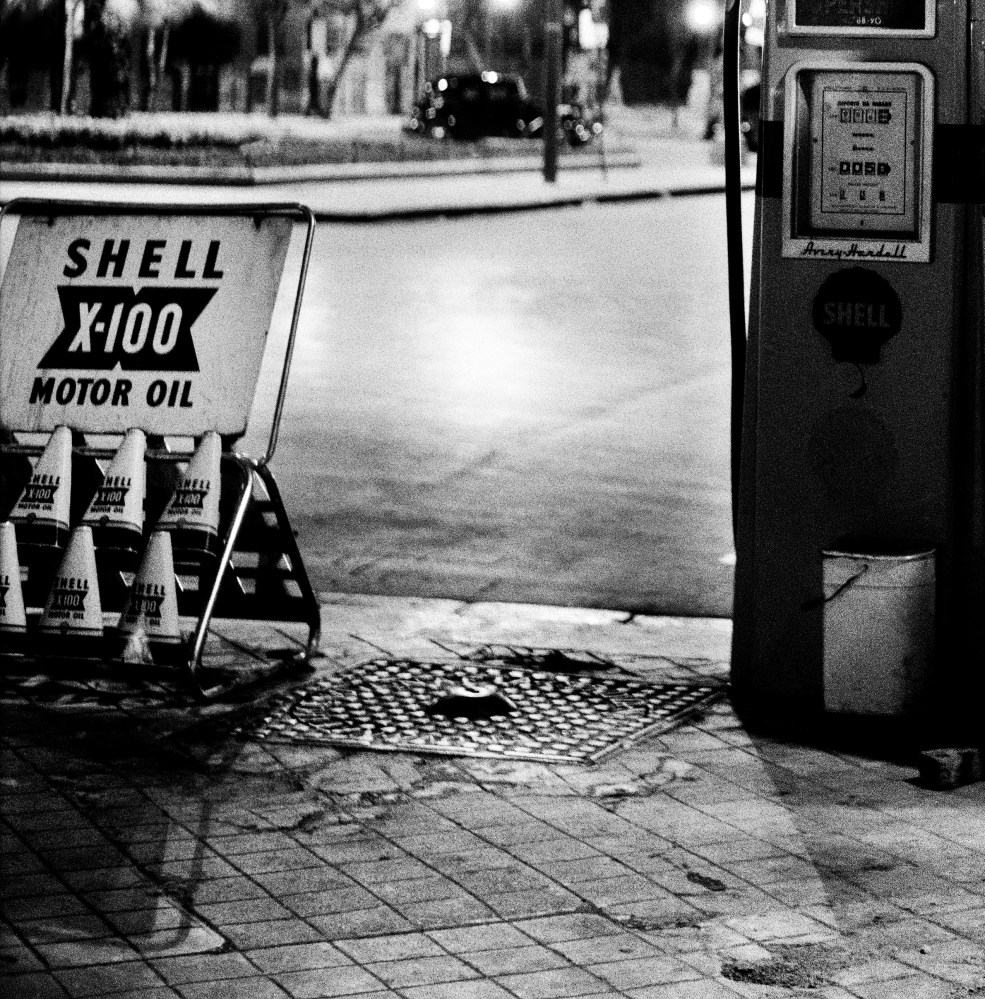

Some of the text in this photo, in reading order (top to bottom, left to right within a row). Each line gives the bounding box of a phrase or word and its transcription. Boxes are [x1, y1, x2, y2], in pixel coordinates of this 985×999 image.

[63, 238, 224, 279] SHELL
[823, 301, 890, 328] SHELL
[67, 302, 183, 355] X-100
[28, 377, 194, 408] MOTOR OIL
[30, 474, 60, 485] HELL
[102, 476, 131, 486] HELL
[134, 583, 165, 595] HELL
[56, 594, 80, 607] X100
